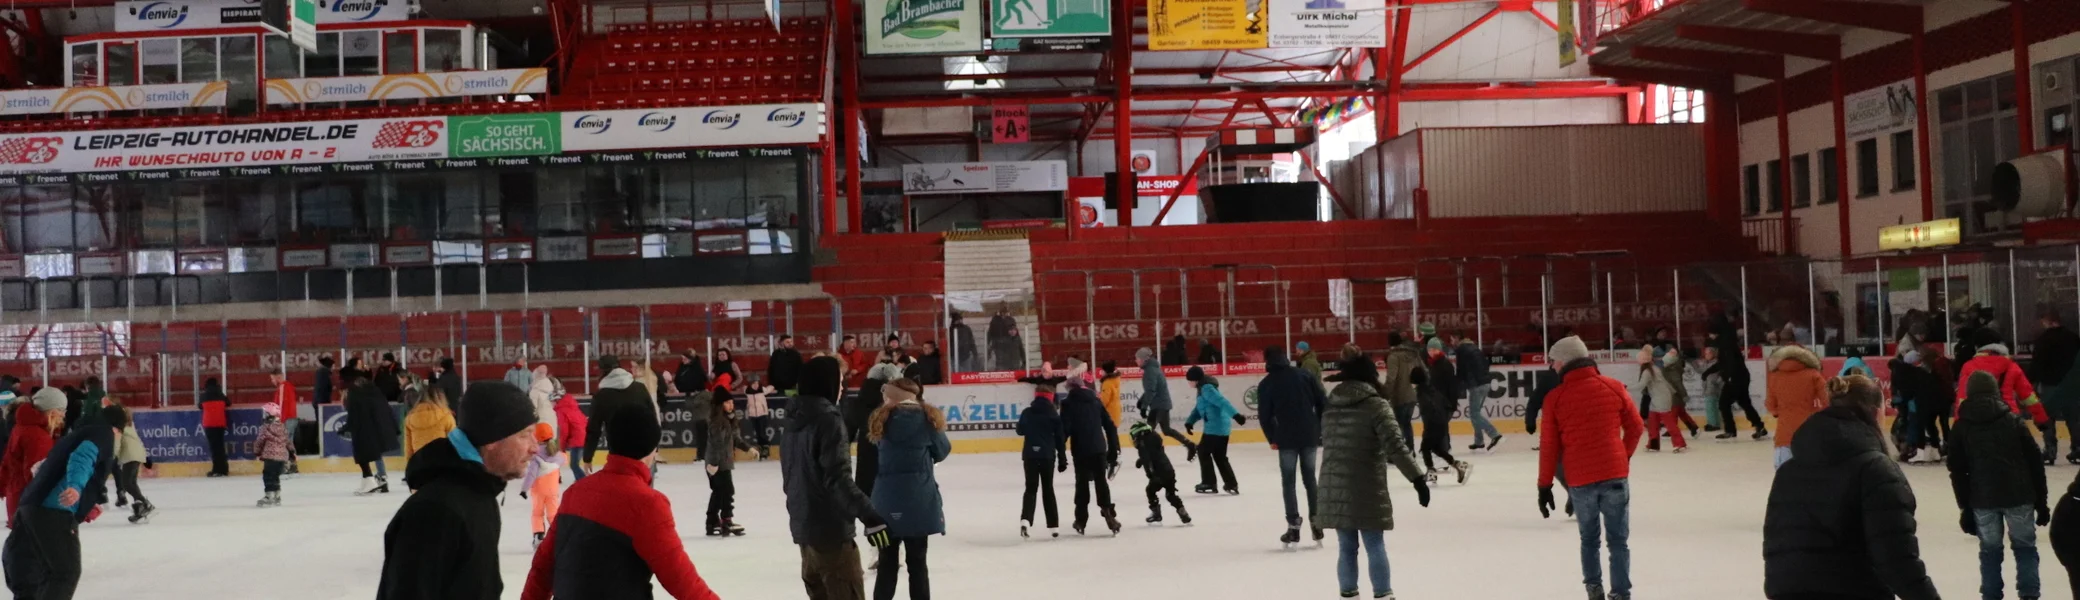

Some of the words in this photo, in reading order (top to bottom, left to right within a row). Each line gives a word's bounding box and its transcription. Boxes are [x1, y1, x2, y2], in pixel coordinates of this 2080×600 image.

[223, 9, 261, 17] EISPIRATE
[901, 0, 961, 22] Brambacher
[884, 12, 900, 33] Bad
[0, 95, 50, 111] stmilch
[485, 126, 503, 138] SO
[505, 124, 533, 137] GEHT
[1005, 119, 1018, 139] A
[74, 124, 358, 151] LEIPZIG-AUTOHANDEL.DE
[463, 134, 547, 153] SÄCHSISCH.
[655, 151, 687, 160] freenet
[708, 149, 739, 159] freenet
[761, 148, 792, 157] freenet
[94, 156, 123, 168] IHR
[129, 151, 245, 166] WUNSCHAUTO
[251, 149, 286, 161] VON
[291, 148, 303, 159] A
[498, 156, 529, 166] freenet
[550, 155, 582, 164] freenet
[602, 153, 634, 162] freenet
[343, 163, 374, 171] freenet
[395, 161, 425, 169] freenet
[446, 158, 477, 167] freenet
[190, 169, 220, 177] freenet
[241, 167, 271, 175] freenet
[292, 165, 322, 173] freenet
[37, 175, 68, 183] freenet
[139, 171, 170, 179] freenet
[1137, 180, 1180, 189] AN-SHOP
[718, 337, 785, 351] KLECK
[140, 355, 221, 373] КЯКСА
[143, 424, 190, 439] wollen.
